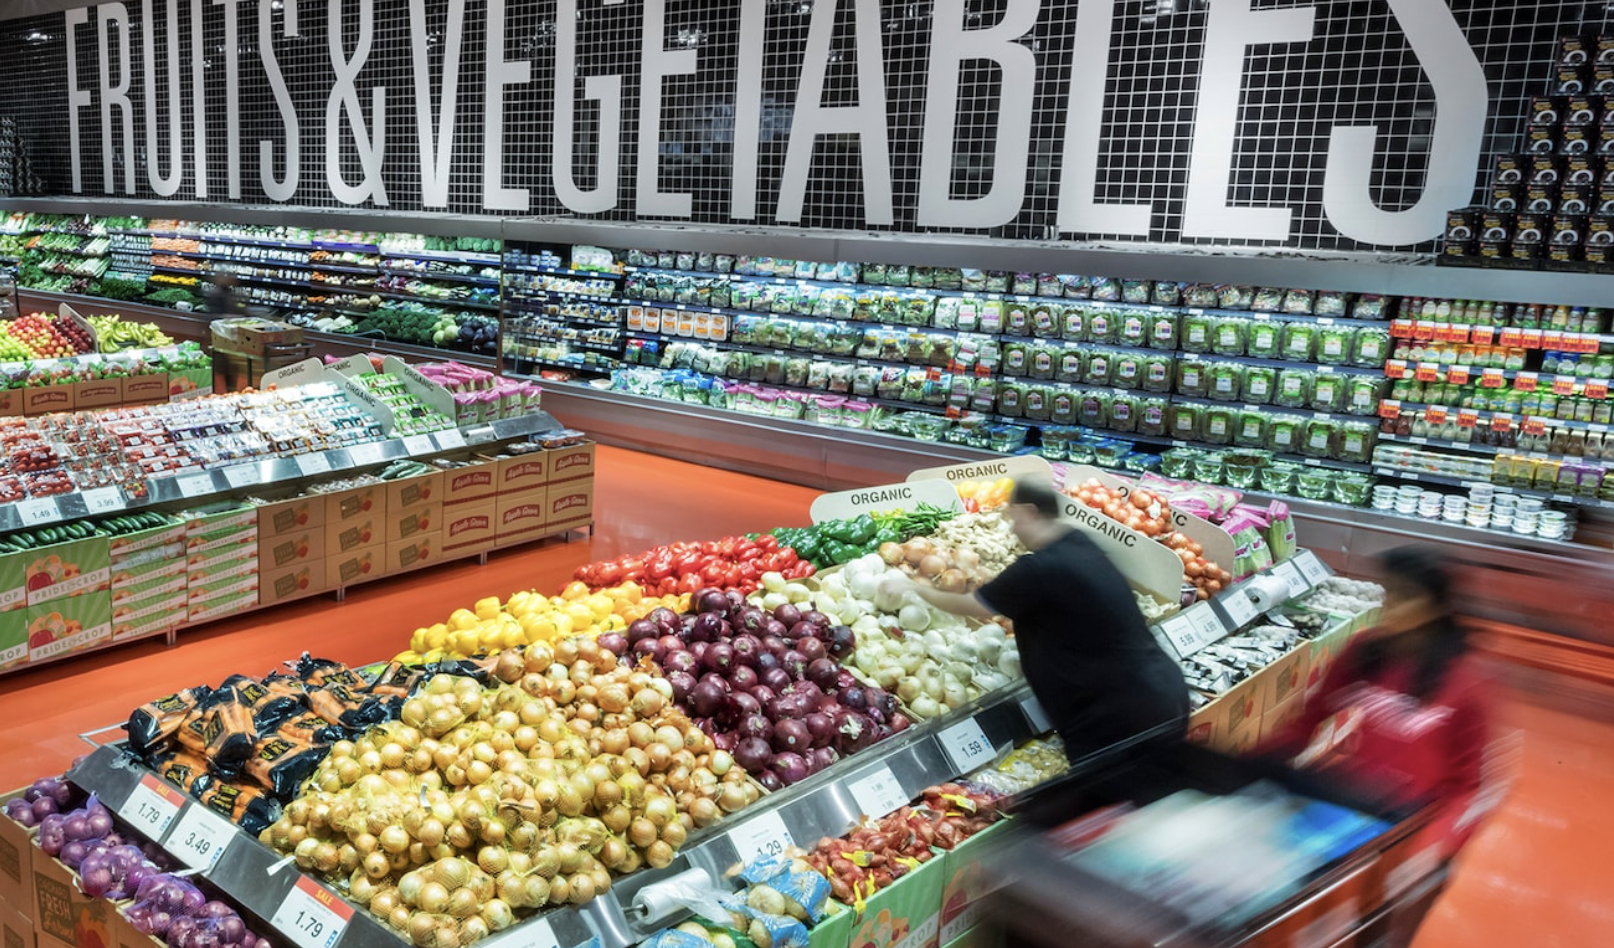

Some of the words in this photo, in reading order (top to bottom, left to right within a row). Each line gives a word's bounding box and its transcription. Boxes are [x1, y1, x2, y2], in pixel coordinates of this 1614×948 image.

[65, 0, 299, 201] FRUITS
[326, 0, 390, 206] &
[408, 0, 1489, 247] VEGETABLES
[278, 364, 305, 380] ORGANIC
[404, 367, 434, 392] ORGANIC
[344, 381, 376, 408] ORGANIC
[946, 463, 1008, 481] ORGANIC
[851, 487, 912, 506] ORGANIC
[32, 509, 51, 519] 1.49
[1064, 503, 1137, 548] ORGANIC
[34, 587, 66, 601] PRIDE
[76, 572, 104, 586] CROP
[36, 642, 67, 658] PRIDE
[961, 740, 983, 759] 1.59
[156, 783, 171, 797] SALE
[138, 802, 160, 824] 1.79
[184, 832, 211, 856] 3.49
[756, 839, 783, 857] 129
[40, 889, 71, 921] FRESH
[314, 888, 334, 907] SALE
[295, 910, 323, 938] 1.79
[947, 911, 976, 939] PRID
